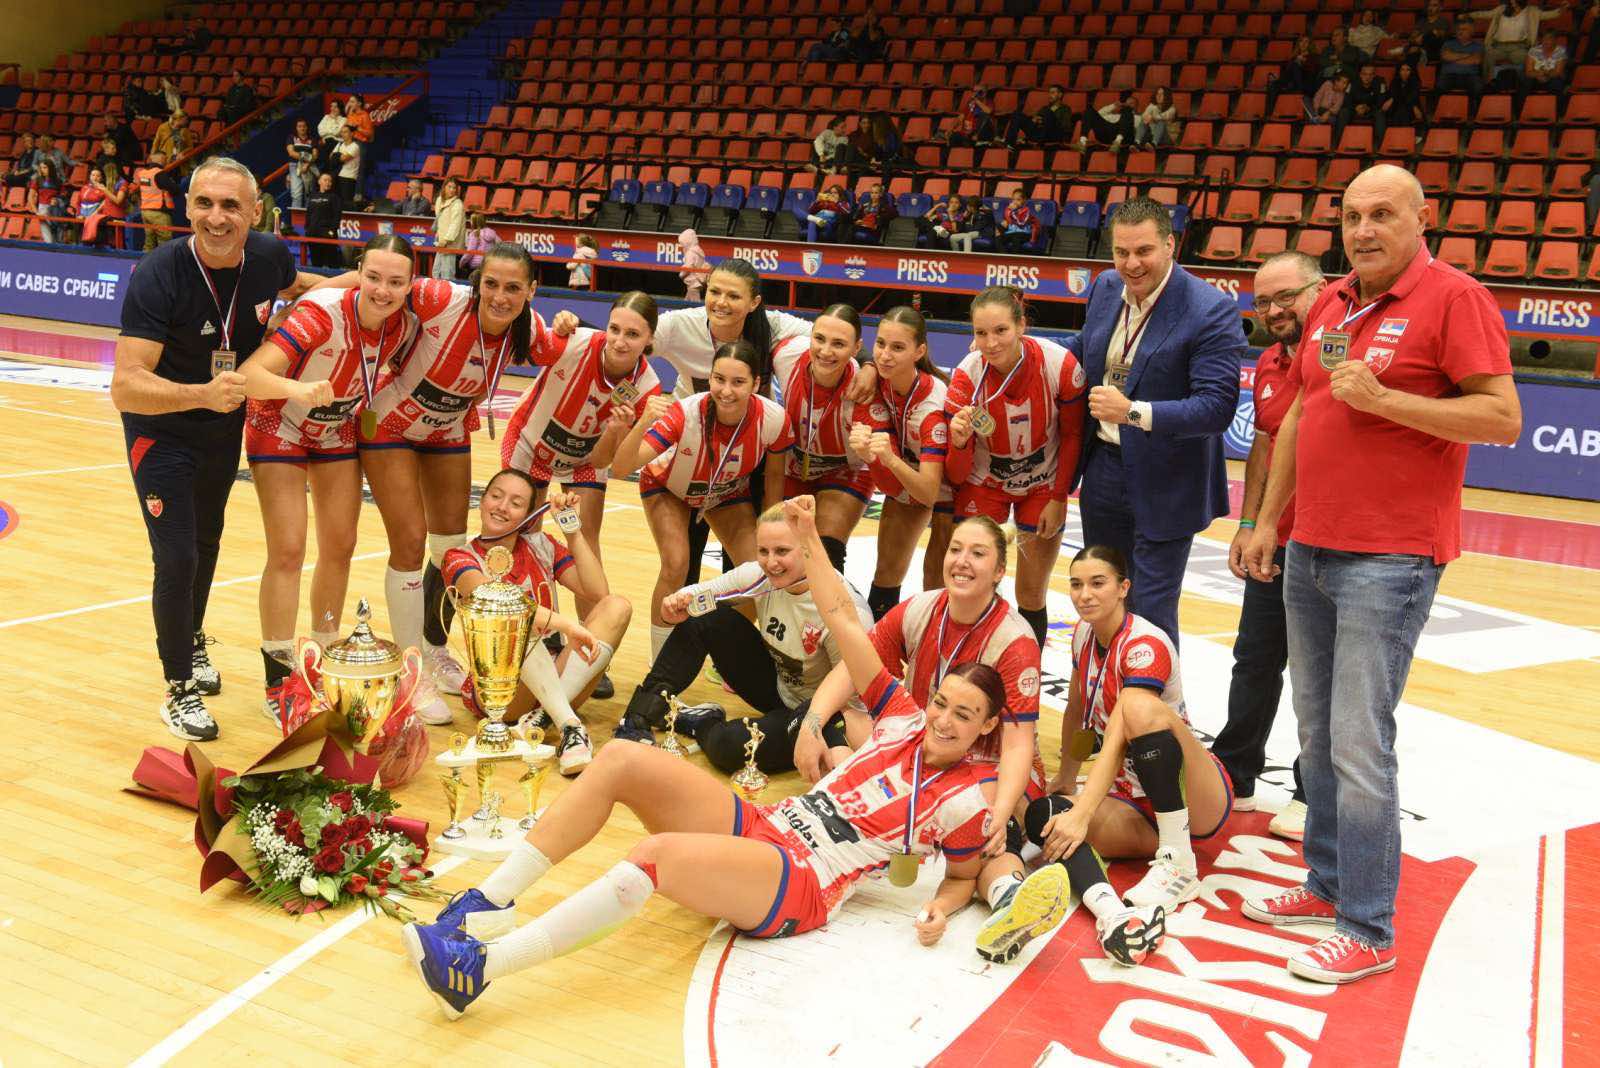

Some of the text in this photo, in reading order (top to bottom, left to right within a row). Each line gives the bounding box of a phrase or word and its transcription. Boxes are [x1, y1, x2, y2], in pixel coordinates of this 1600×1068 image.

[337, 219, 361, 240] ESS
[515, 231, 555, 254] PRESS
[656, 241, 687, 264] PRE
[733, 246, 779, 271] PRESS
[897, 258, 949, 284] PRESS
[15, 272, 60, 294] САВЕЗ
[63, 277, 116, 300] СРБИЈЕ
[985, 263, 1040, 290] PRESS
[1517, 297, 1593, 328] PRESS
[580, 416, 595, 434] 5
[766, 616, 787, 642] 28
